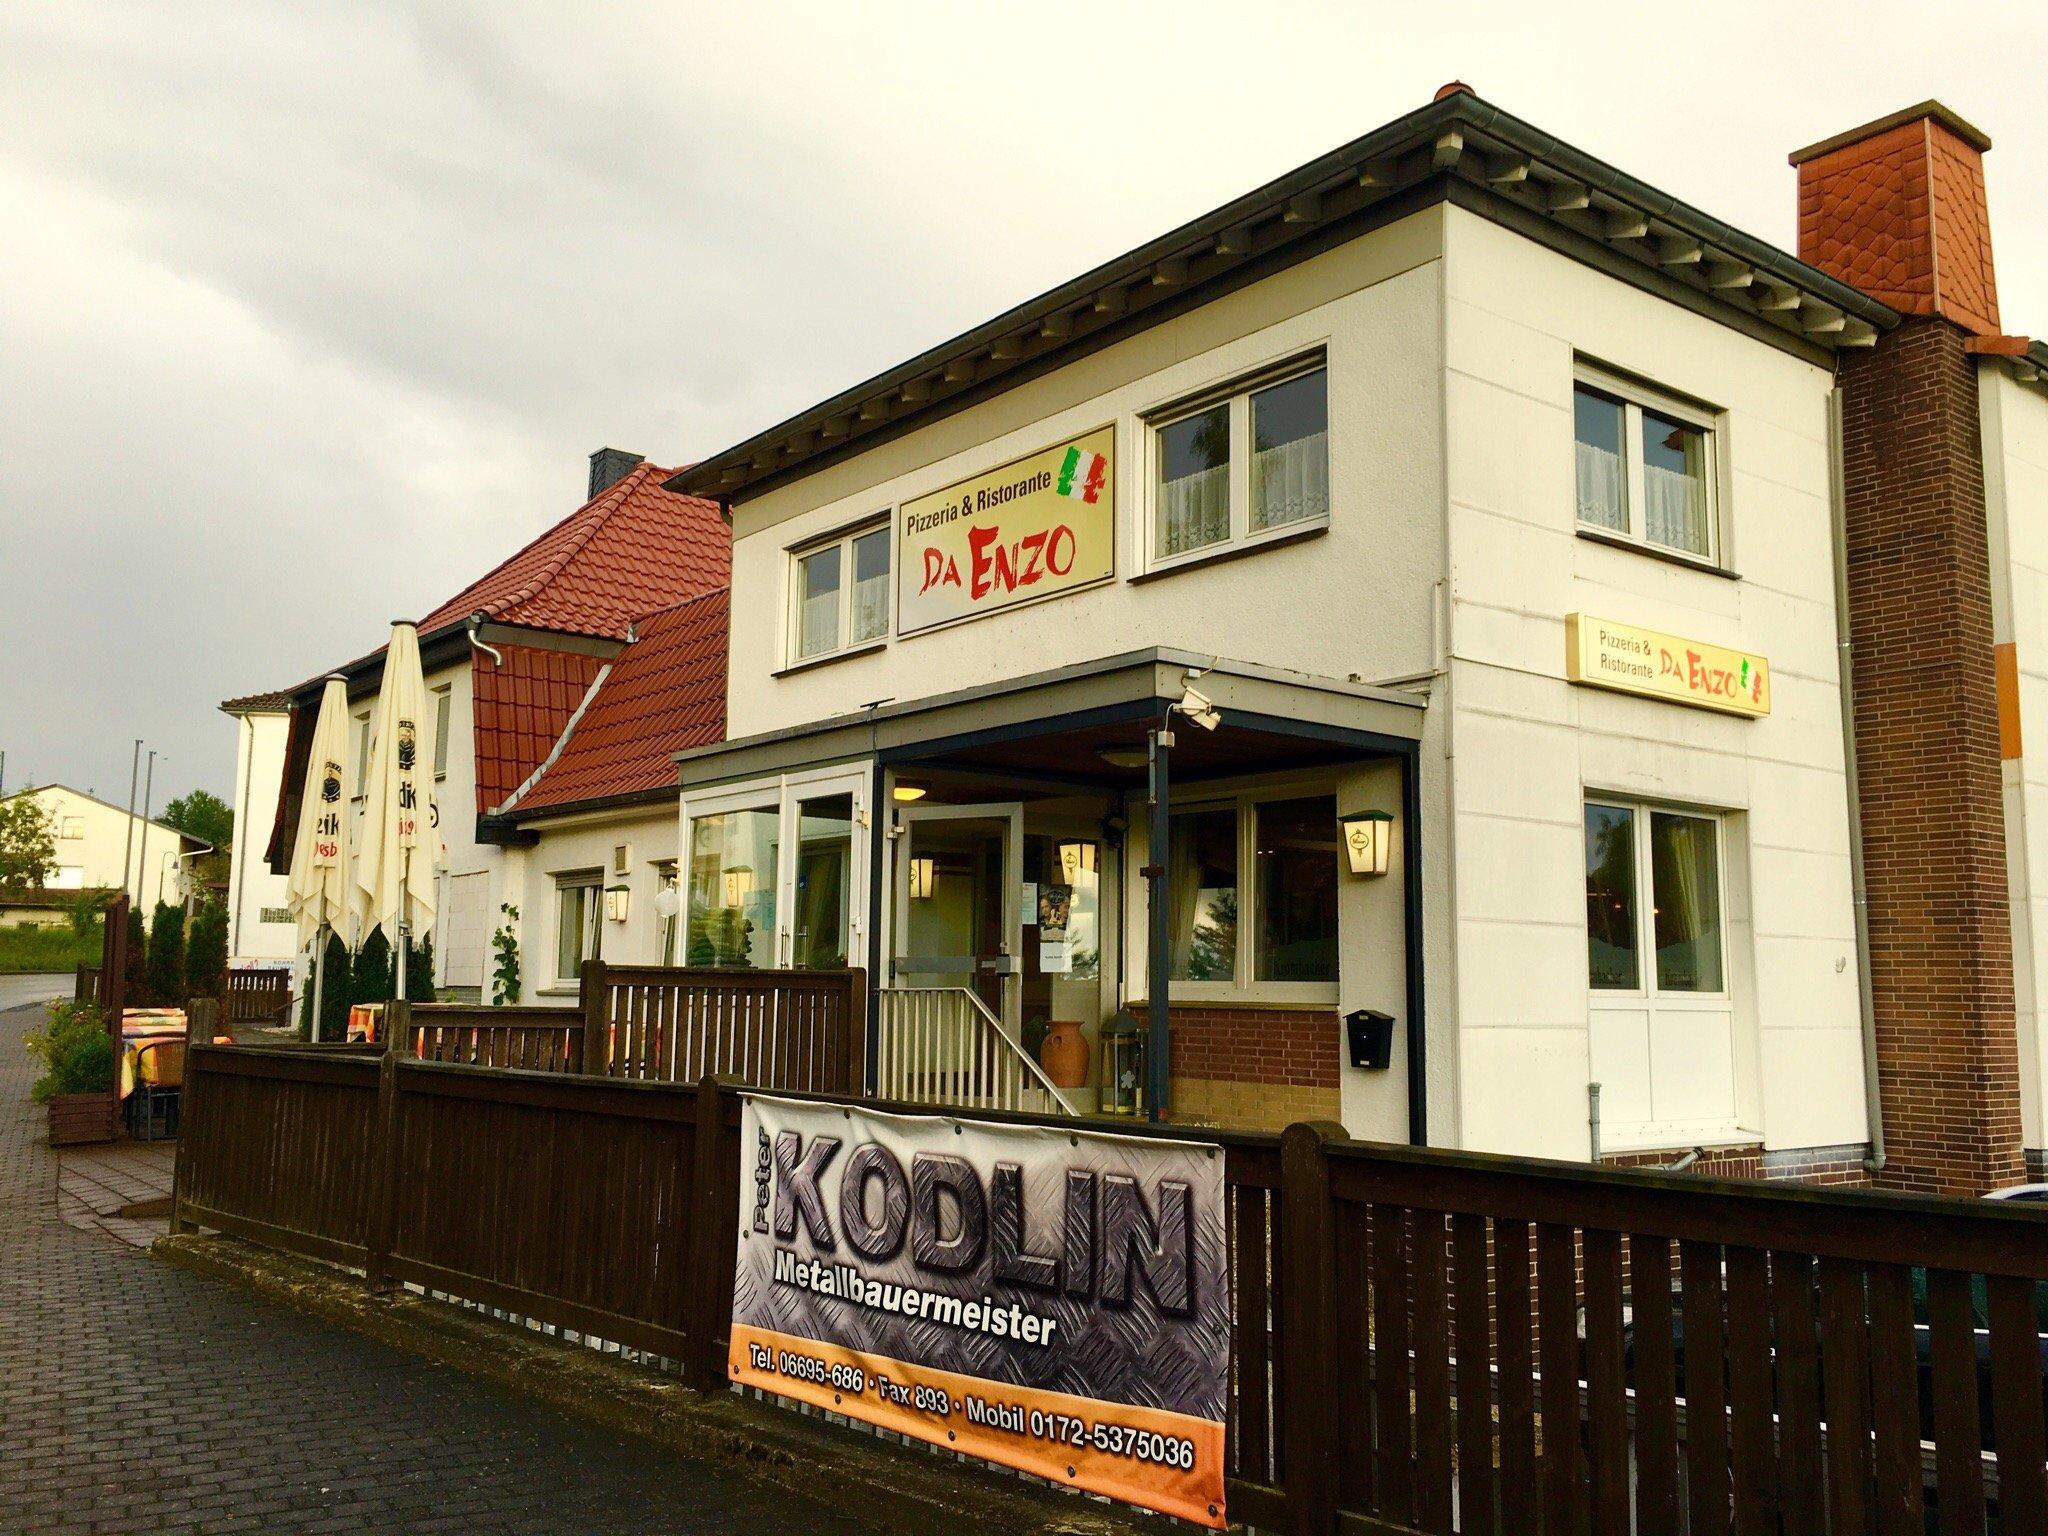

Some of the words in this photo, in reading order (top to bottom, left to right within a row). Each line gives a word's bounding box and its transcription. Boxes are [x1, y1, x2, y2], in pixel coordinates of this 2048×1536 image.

[907, 503, 958, 536] Pizzeria
[961, 495, 973, 517] &
[977, 471, 1052, 512] Ristorante
[918, 547, 961, 597] DA
[967, 524, 1076, 601] ENZO
[1600, 630, 1641, 654] Pizzeria
[1643, 640, 1651, 656] &
[1600, 653, 1653, 679] Ristorante
[1659, 648, 1684, 682] DA
[1686, 649, 1738, 698] ENZO
[752, 1125, 773, 1235] Peter
[774, 1130, 1196, 1318] KODLIN
[774, 1249, 1057, 1346] Metallbauermeister
[750, 1344, 775, 1370] Tel.
[779, 1352, 864, 1392] 06695-686
[879, 1375, 911, 1405] Fax
[915, 1385, 949, 1414] 893
[966, 1396, 1025, 1433] Mobil
[1030, 1410, 1194, 1469] 0172-5375036
